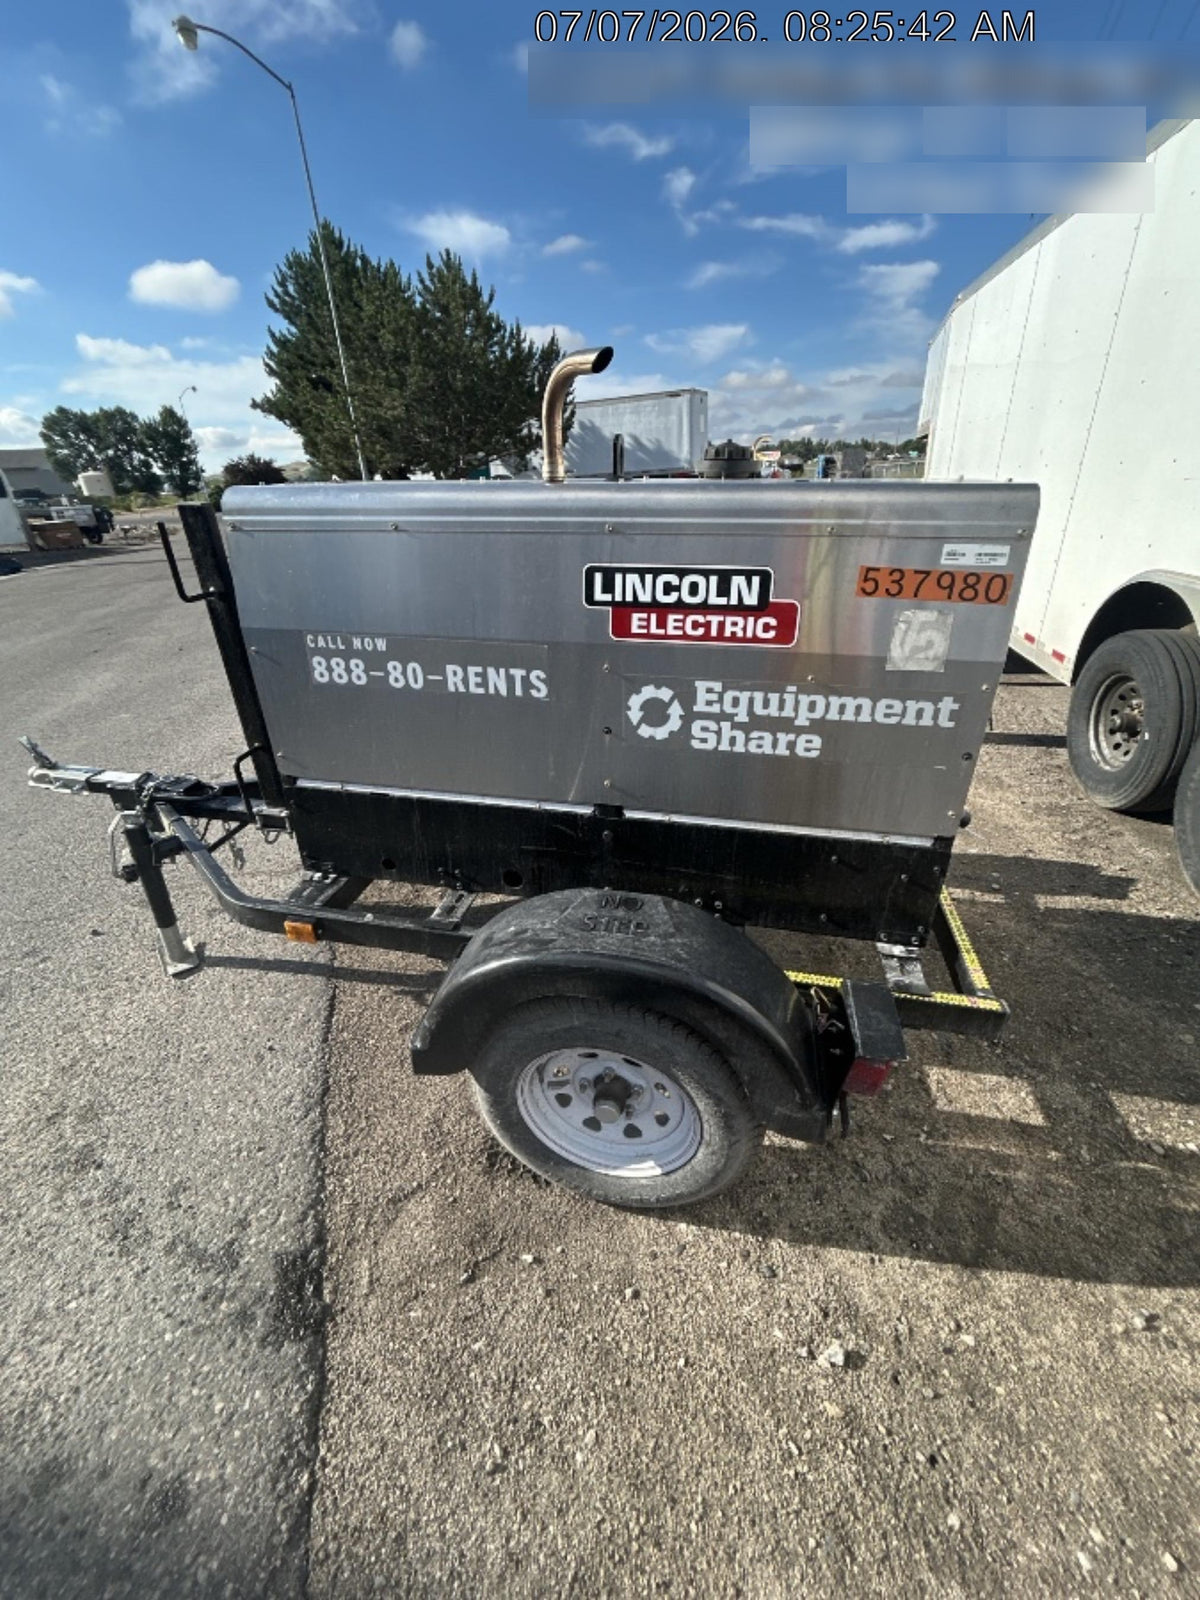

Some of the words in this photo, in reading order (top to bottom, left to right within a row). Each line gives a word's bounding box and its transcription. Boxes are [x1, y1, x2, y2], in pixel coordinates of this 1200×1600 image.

[593, 572, 760, 606] LINCOLN
[860, 567, 1008, 603] 537980
[306, 634, 346, 650] CALL
[353, 636, 387, 652] NOW
[630, 612, 778, 640] ELECTRIC
[312, 655, 549, 699] 888-80-RENTS
[692, 679, 961, 728] Equipment
[690, 719, 823, 759] Share
